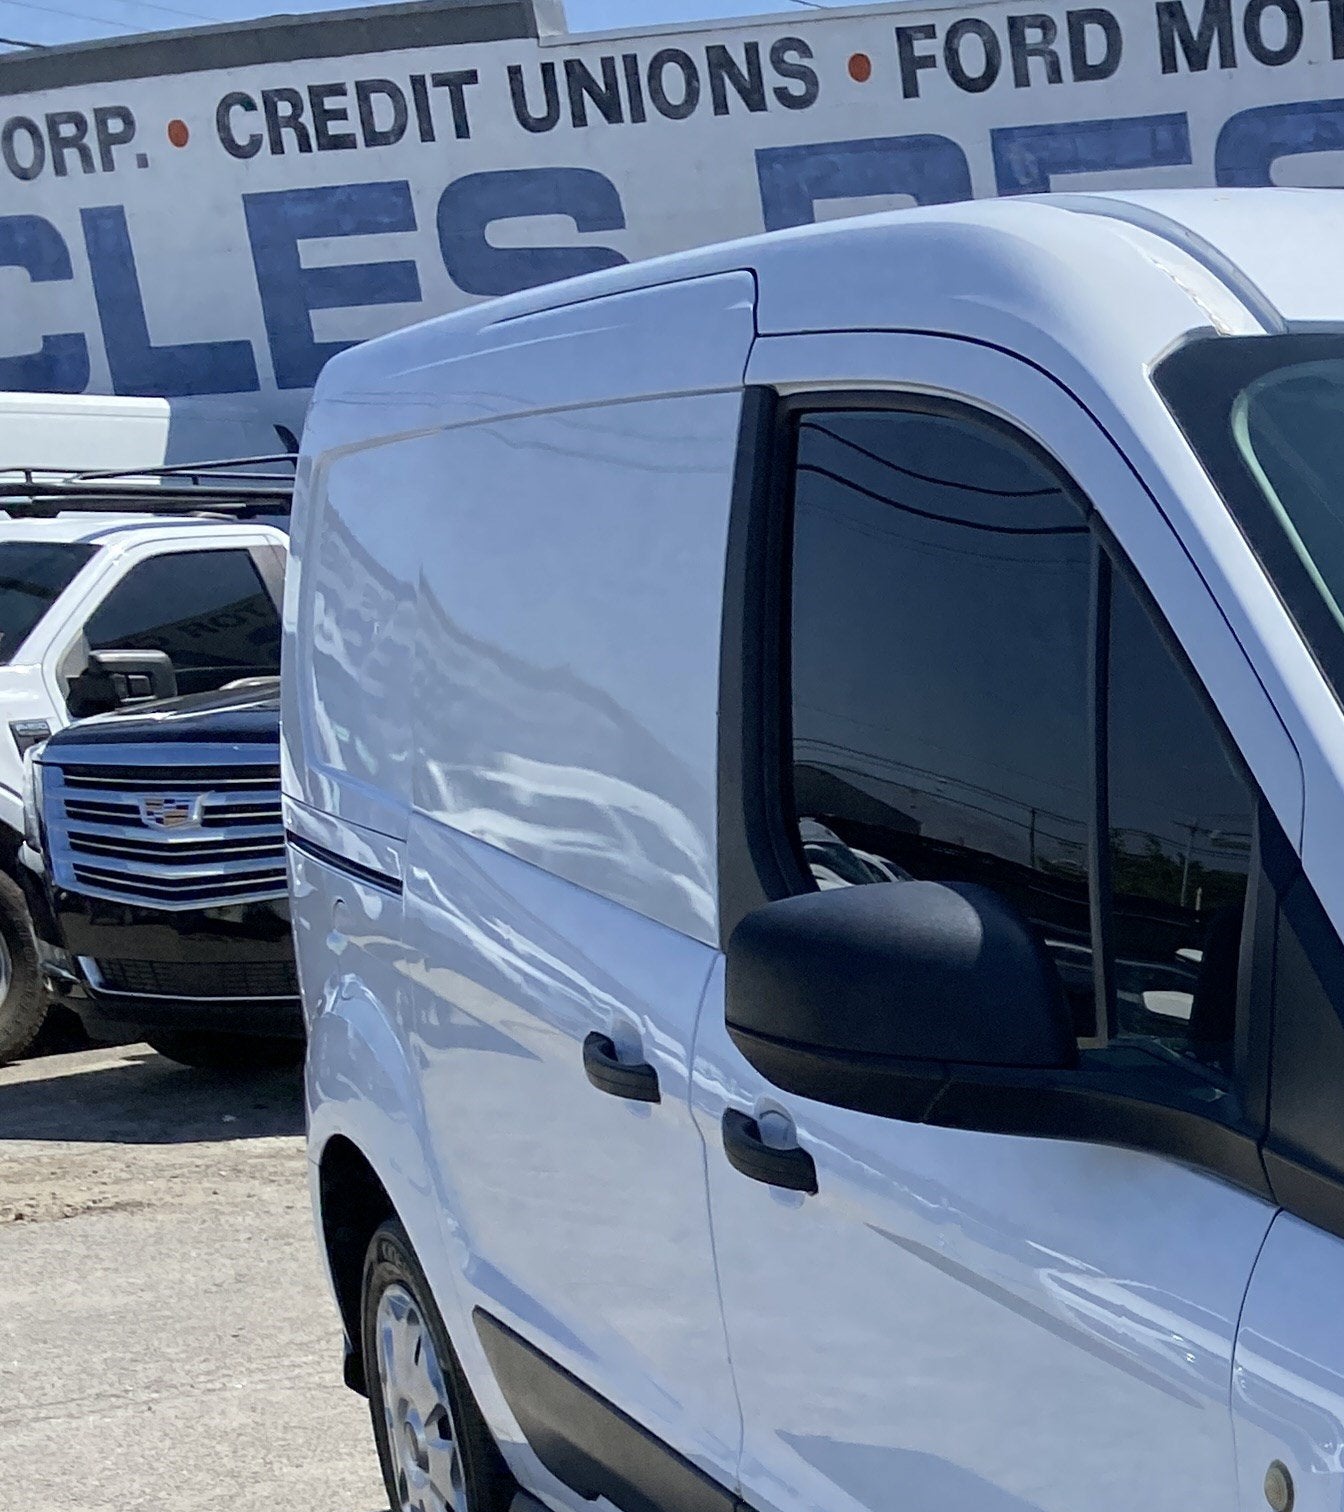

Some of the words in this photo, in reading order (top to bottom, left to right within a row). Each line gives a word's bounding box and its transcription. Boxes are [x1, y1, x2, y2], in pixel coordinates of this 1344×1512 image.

[2, 105, 149, 181] ORP.
[216, 69, 478, 159] CREDIT
[507, 37, 820, 134] UNIONS
[896, 14, 1123, 99] FORD
